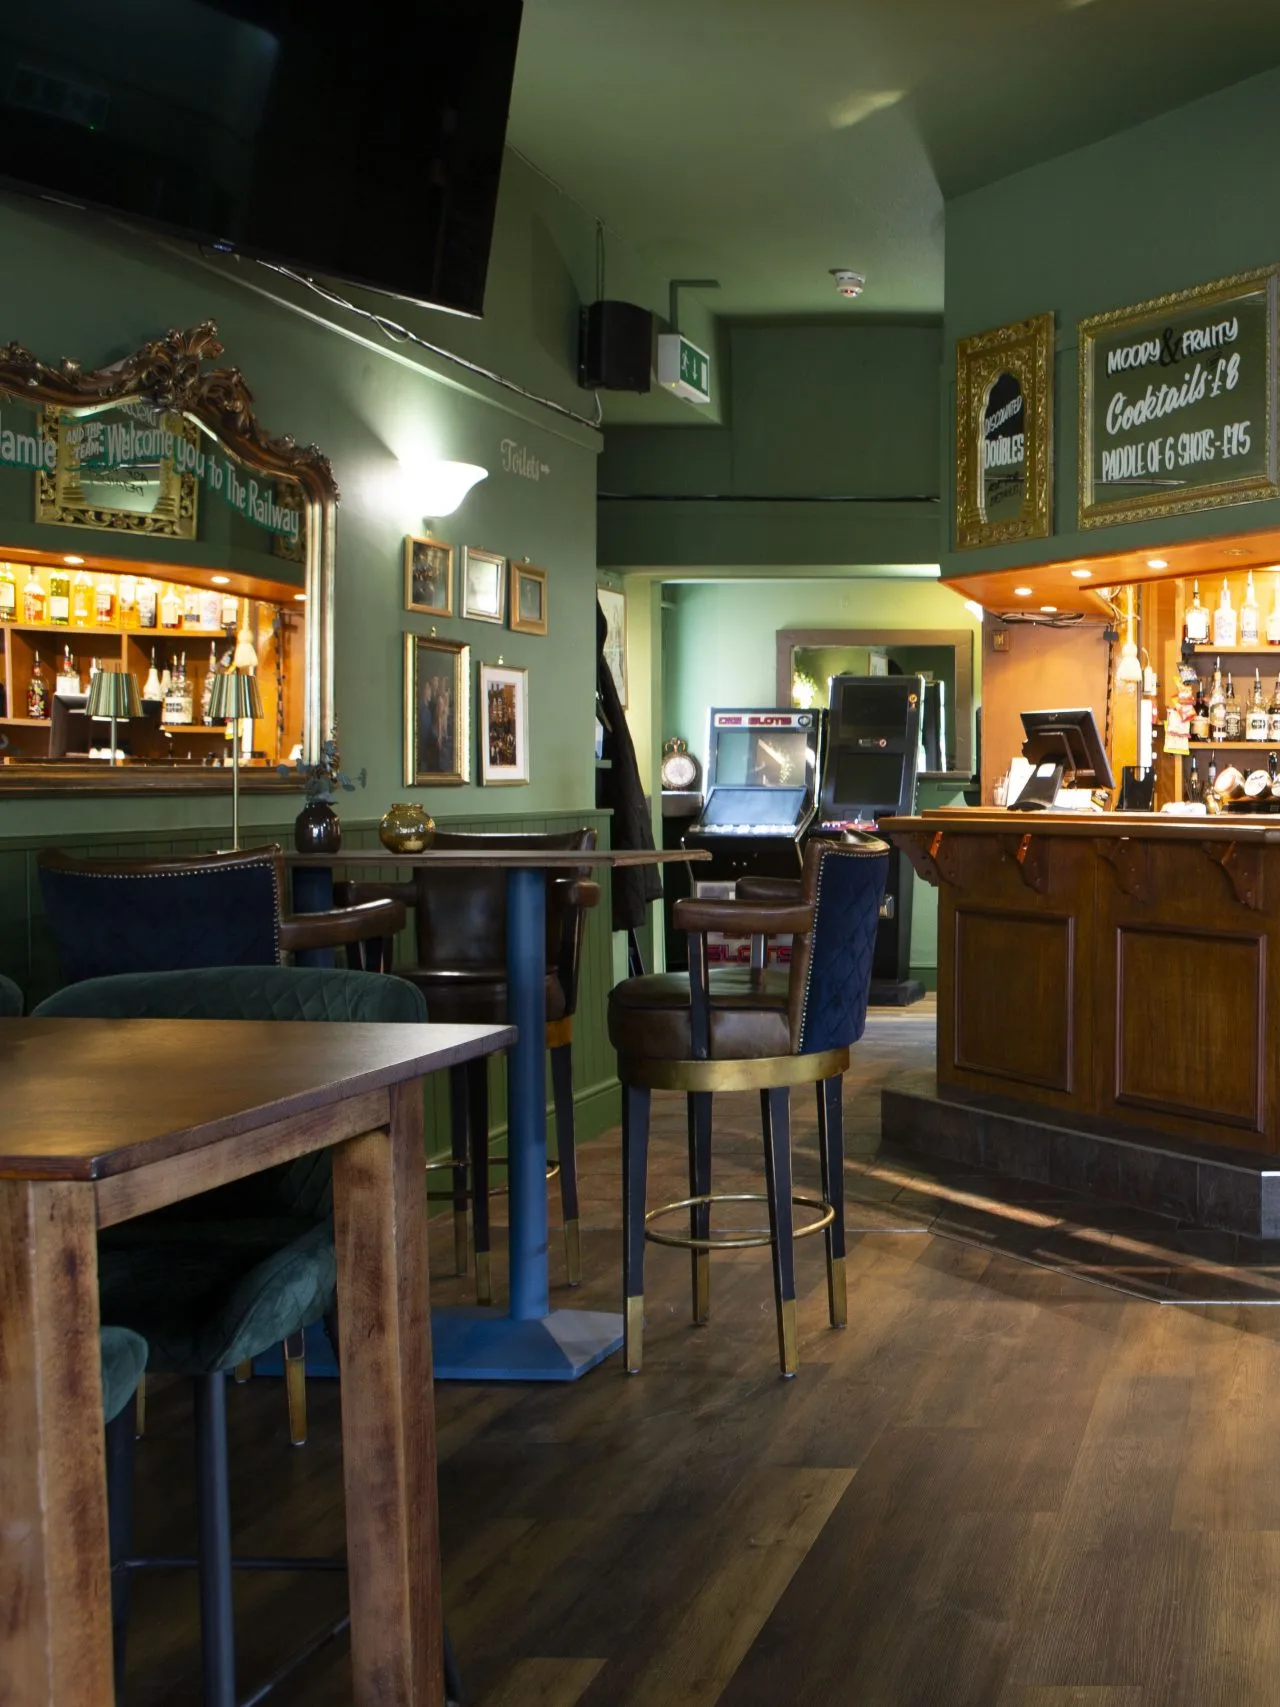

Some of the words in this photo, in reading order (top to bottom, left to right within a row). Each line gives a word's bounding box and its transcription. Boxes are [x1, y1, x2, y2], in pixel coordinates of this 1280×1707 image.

[1107, 338, 1161, 375] MOODY
[1158, 327, 1183, 367] &
[1181, 316, 1239, 356] FRUITY
[0, 410, 58, 468] amie
[66, 426, 85, 445] AND
[984, 433, 1025, 470] DOUBLES
[1102, 442, 1146, 483] PADDLE
[1147, 437, 1162, 473] OF
[1165, 436, 1175, 470] 6
[107, 421, 174, 466] Welcome
[176, 436, 206, 477] you
[208, 455, 223, 490] to
[226, 461, 247, 508] The
[249, 478, 299, 543] Railway
